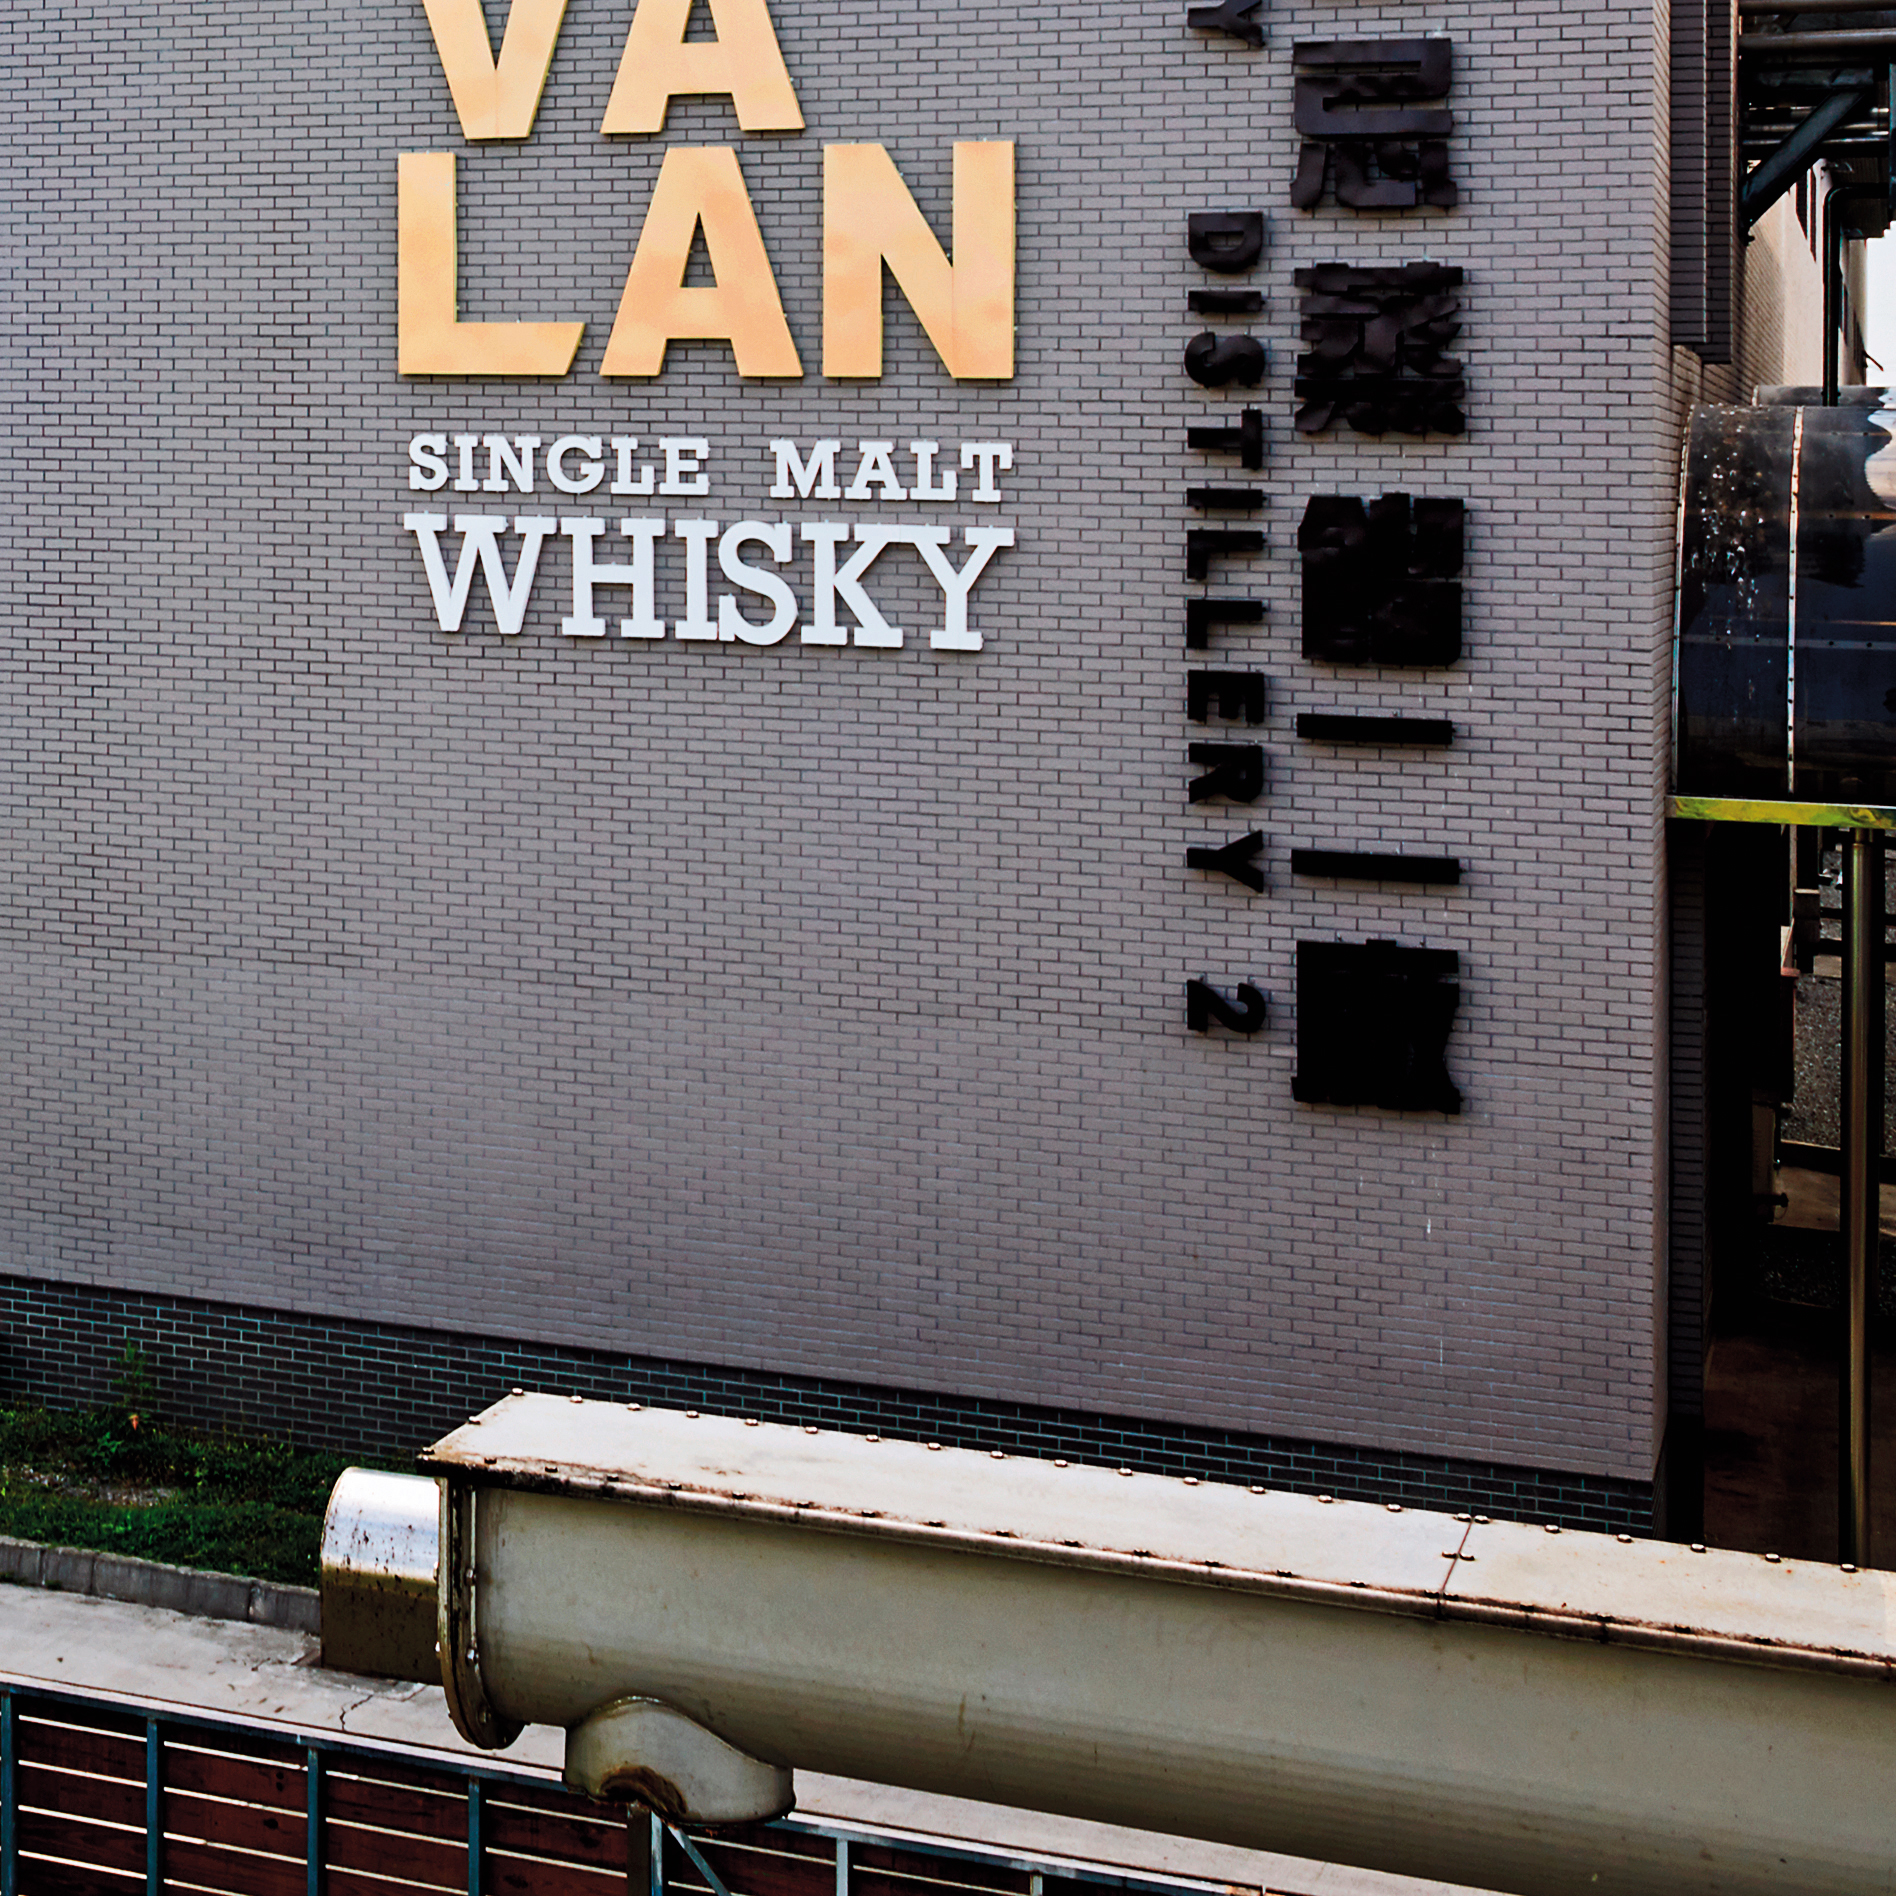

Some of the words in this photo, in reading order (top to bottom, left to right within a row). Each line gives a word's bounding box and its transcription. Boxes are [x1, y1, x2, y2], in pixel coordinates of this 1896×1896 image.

[397, 140, 1015, 379] LAN
[408, 434, 710, 497] SINGLE
[769, 438, 1013, 503] MALT
[404, 513, 1014, 652] WHISKY
[1184, 212, 1265, 893] DISTILLERY
[1187, 979, 1266, 1032] 2
